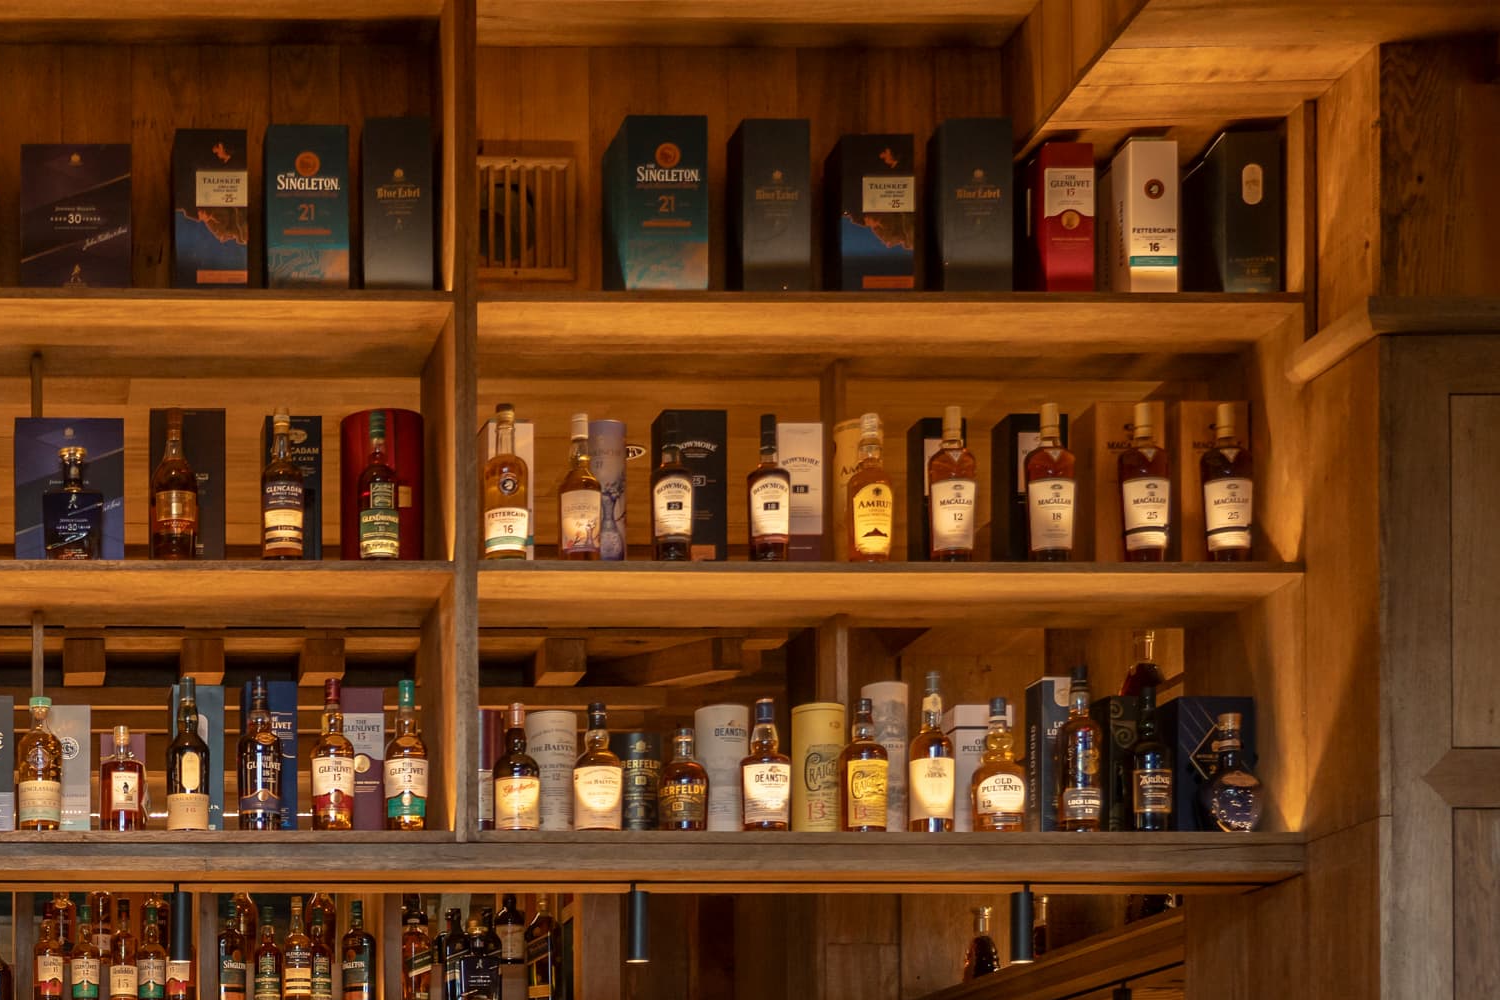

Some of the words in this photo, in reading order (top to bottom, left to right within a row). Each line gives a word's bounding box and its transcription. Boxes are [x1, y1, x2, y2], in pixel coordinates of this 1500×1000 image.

[636, 165, 700, 183] SINGLETON
[202, 177, 241, 185] TALISKER
[276, 174, 340, 191] SINGLETON
[868, 182, 908, 190] TALISKER
[1050, 179, 1090, 189] GLENLIVET
[1065, 187, 1076, 197] 15
[658, 195, 676, 213] 21
[298, 203, 316, 221] 21
[68, 213, 82, 225] 30
[1131, 226, 1177, 234] FETTERCAIRN
[1148, 242, 1160, 253] 16
[266, 485, 303, 495] GLENCADAM
[953, 512, 963, 521] 12
[1051, 511, 1062, 521] 18
[1146, 511, 1158, 520] 25
[1227, 511, 1239, 520] 25
[503, 524, 514, 534] 16
[357, 732, 366, 741] 15
[333, 773, 342, 782] 15
[755, 774, 788, 784] DEANSTON
[994, 778, 1013, 786] OLD
[982, 800, 992, 809] 12
[806, 803, 827, 820] 13
[853, 804, 868, 820] 13
